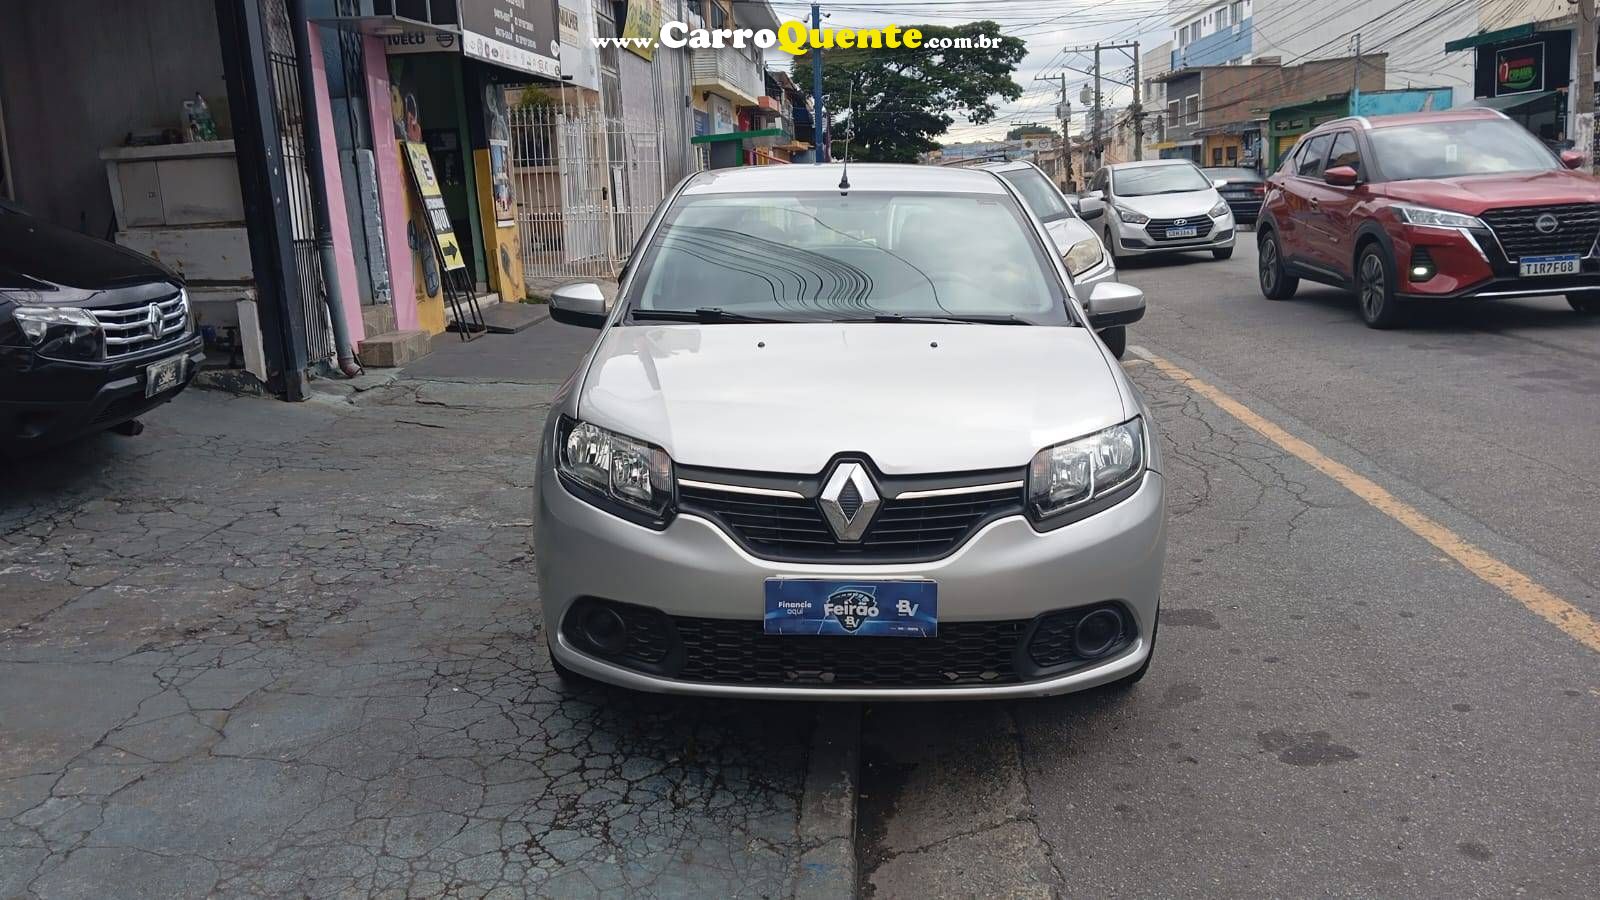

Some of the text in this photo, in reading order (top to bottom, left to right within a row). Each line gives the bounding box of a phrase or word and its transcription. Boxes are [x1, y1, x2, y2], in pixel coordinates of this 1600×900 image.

[1526, 261, 1574, 274] TIR7F08
[787, 608, 803, 616] aqui
[824, 601, 879, 617] Feirão
